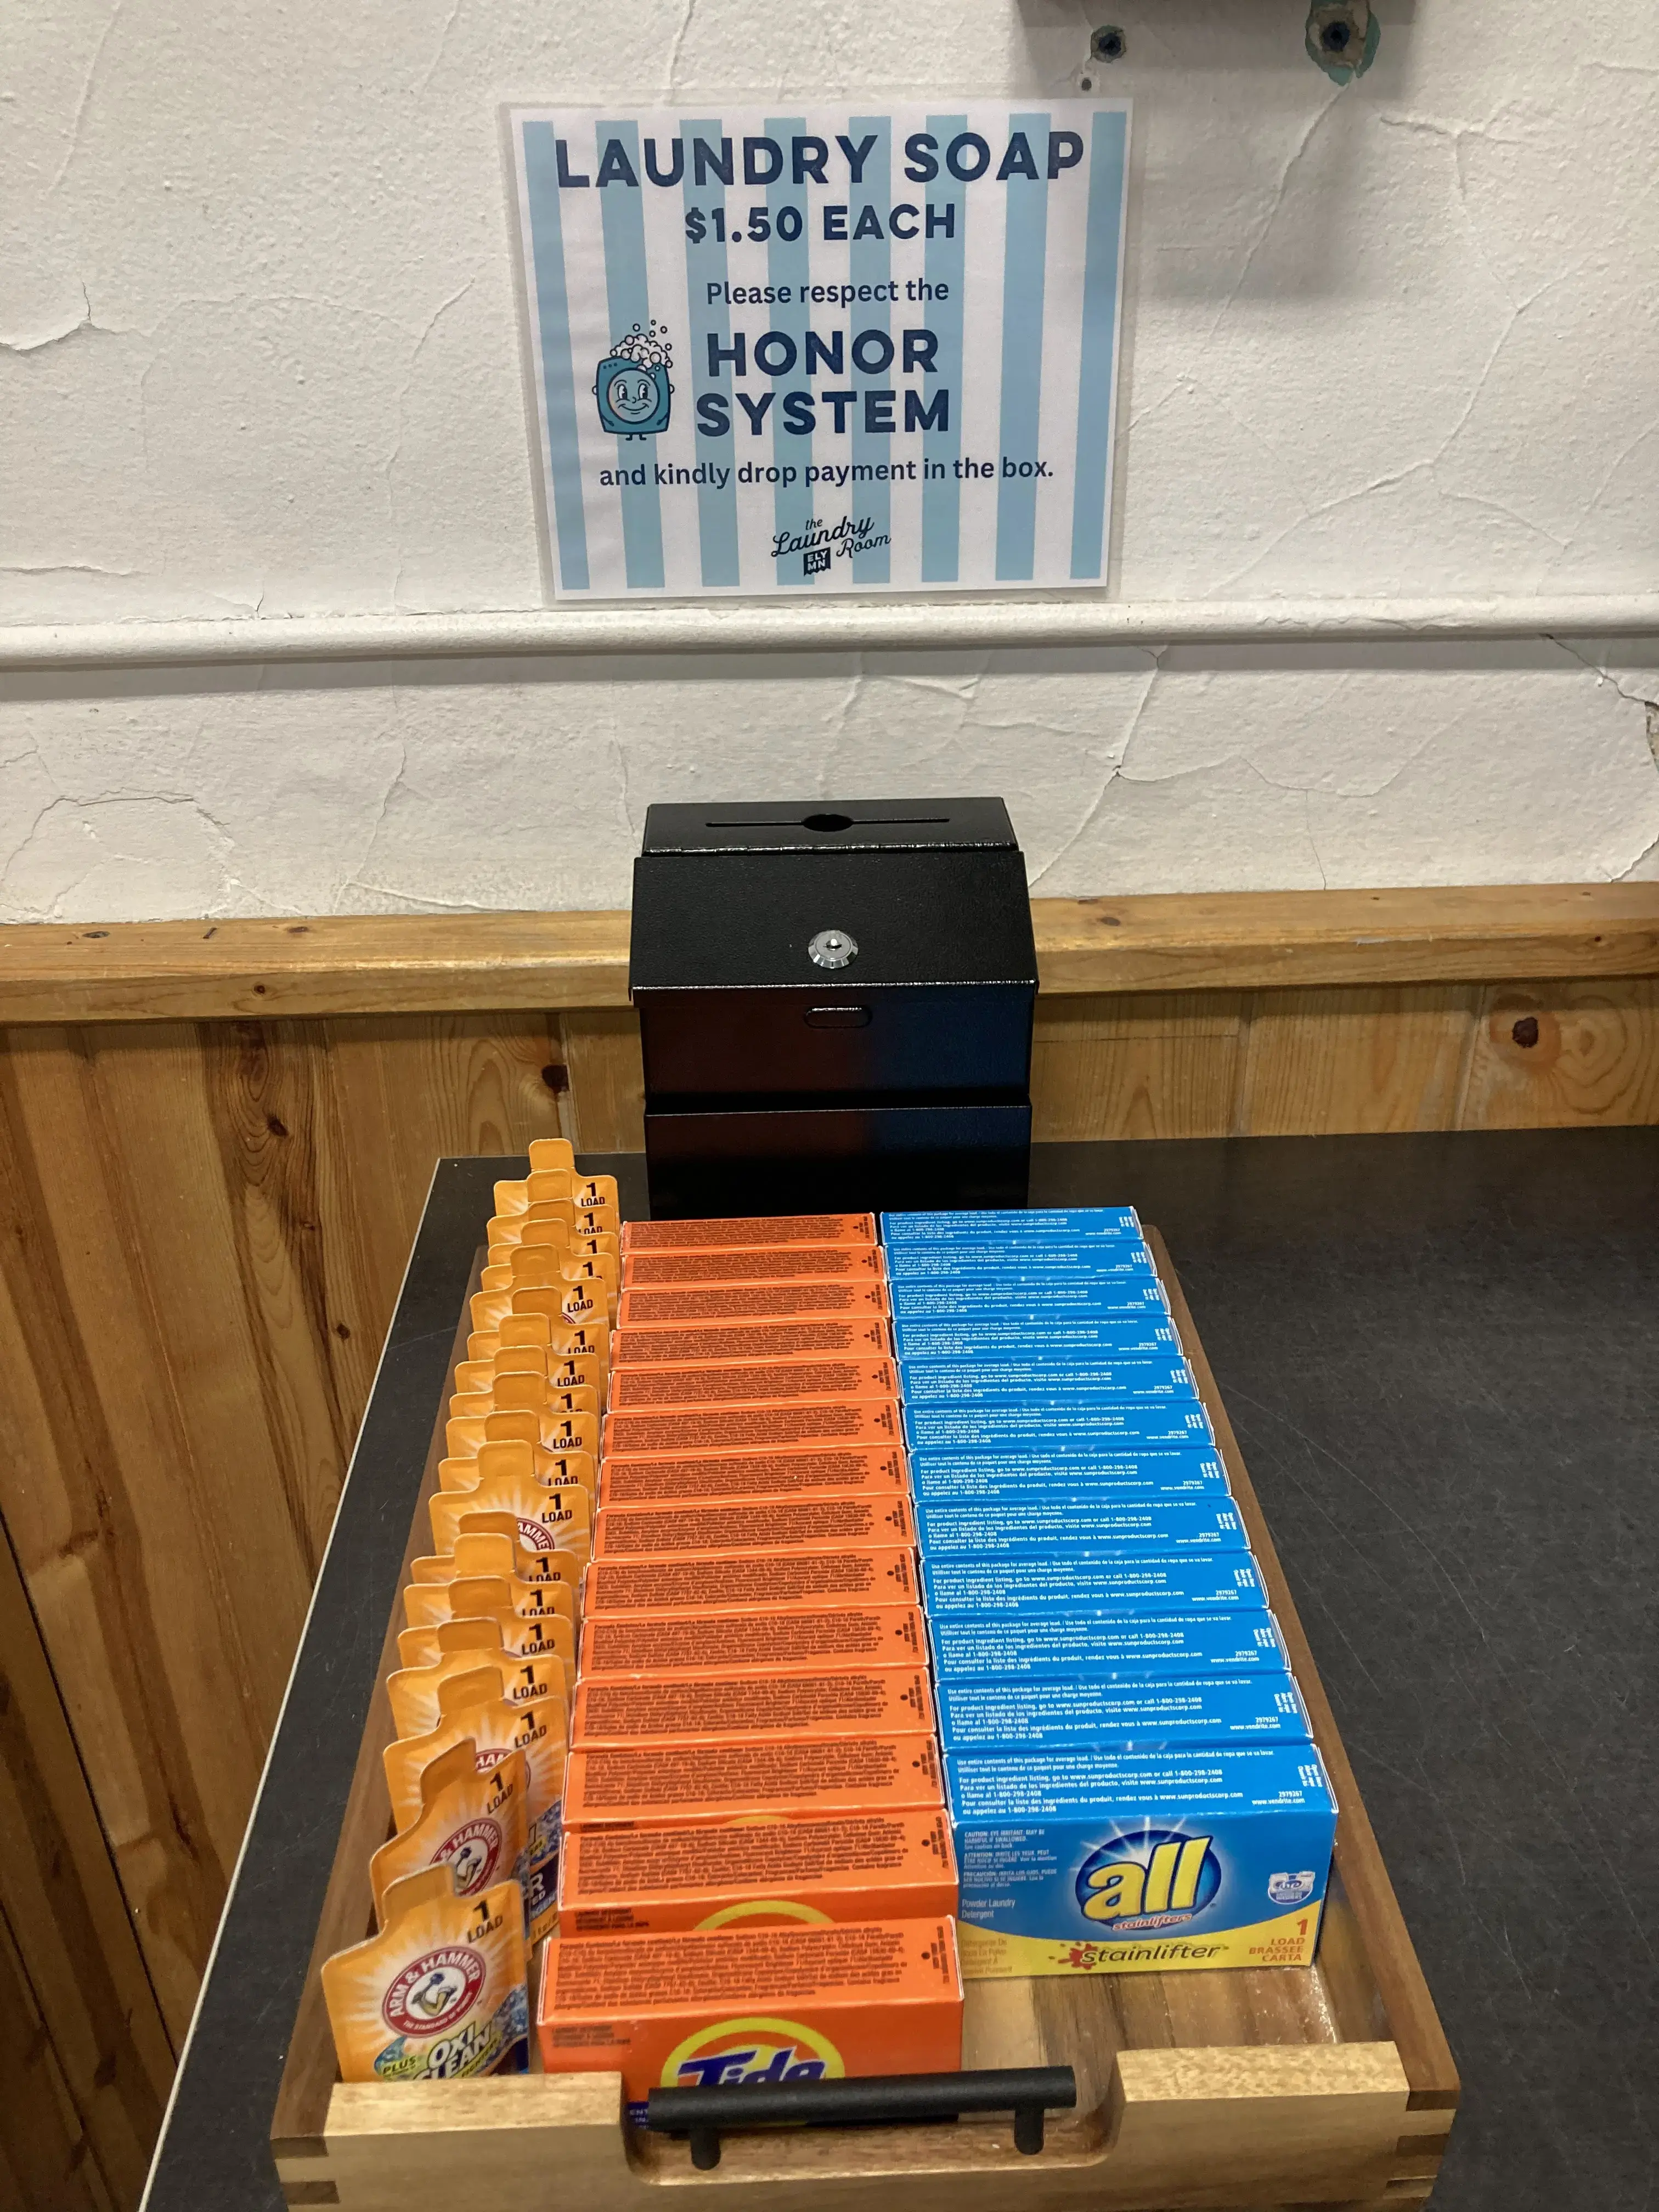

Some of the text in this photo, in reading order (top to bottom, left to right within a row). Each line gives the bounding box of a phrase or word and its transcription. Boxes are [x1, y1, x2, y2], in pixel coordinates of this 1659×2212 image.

[556, 132, 1084, 187] LAUNDRY SOAP
[685, 204, 955, 244] $1.50 EACH
[707, 278, 949, 307] Please respect the
[707, 330, 938, 377] HONOR
[697, 390, 949, 437] SYSTEM
[601, 456, 1053, 489] and kindly drop payment in the box.
[805, 518, 823, 530] the
[771, 516, 875, 557] Laundry
[836, 534, 891, 558] Room
[808, 550, 828, 563] ELY
[808, 560, 826, 571] MN
[586, 1182, 596, 1197] 1
[581, 1197, 605, 1206] LOAD
[584, 1212, 594, 1226] 1
[586, 1240, 597, 1254] 1
[583, 1262, 594, 1276] 1
[573, 1285, 584, 1300] 1
[568, 1300, 593, 1312] LOAD
[574, 1330, 585, 1345] 1
[564, 1361, 575, 1375] 1
[557, 1375, 585, 1387] LOAD
[561, 1393, 573, 1409] 1
[561, 1420, 573, 1436] 1
[553, 1436, 582, 1449] LOAD
[555, 1459, 568, 1475] 1
[549, 1494, 562, 1510] 1
[542, 1510, 572, 1523] LOAD
[517, 1522, 549, 1549] AMME
[536, 1557, 549, 1572] 1
[531, 1590, 544, 1606] 1
[529, 1624, 542, 1641] 1
[522, 1639, 555, 1656] LOAD
[521, 1666, 534, 1684] 1
[953, 1665, 975, 1673] appelez
[513, 1683, 548, 1700] LOAD
[521, 1711, 535, 1730] 1
[515, 1724, 548, 1748] LOAD
[490, 1771, 504, 1791] 1
[1030, 1774, 1050, 1782] listing,
[1040, 1781, 1077, 1790] ingredientes
[1091, 1780, 1119, 1788] producto,
[487, 1784, 513, 1815] LOAD
[1043, 1797, 1077, 1805] ingrédients
[973, 1807, 996, 1815] appelez
[453, 1824, 498, 1850] HAMMER
[1082, 1836, 1214, 1921] all
[473, 1900, 489, 1922] 1
[962, 1898, 1015, 1909] Powder Laundry
[962, 1910, 994, 1920] Detergent
[1111, 1914, 1193, 1931] stainlifters
[467, 1915, 503, 1943] LOAD
[1296, 1918, 1308, 1936] 1
[1271, 1937, 1305, 1945] LOAD
[1082, 1945, 1222, 1964] stainlifter
[1262, 1954, 1302, 1962] CARTA
[390, 1953, 481, 2017] ARM & HAMMER
[427, 2021, 476, 2069] OXI
[383, 2055, 416, 2075] PLUS
